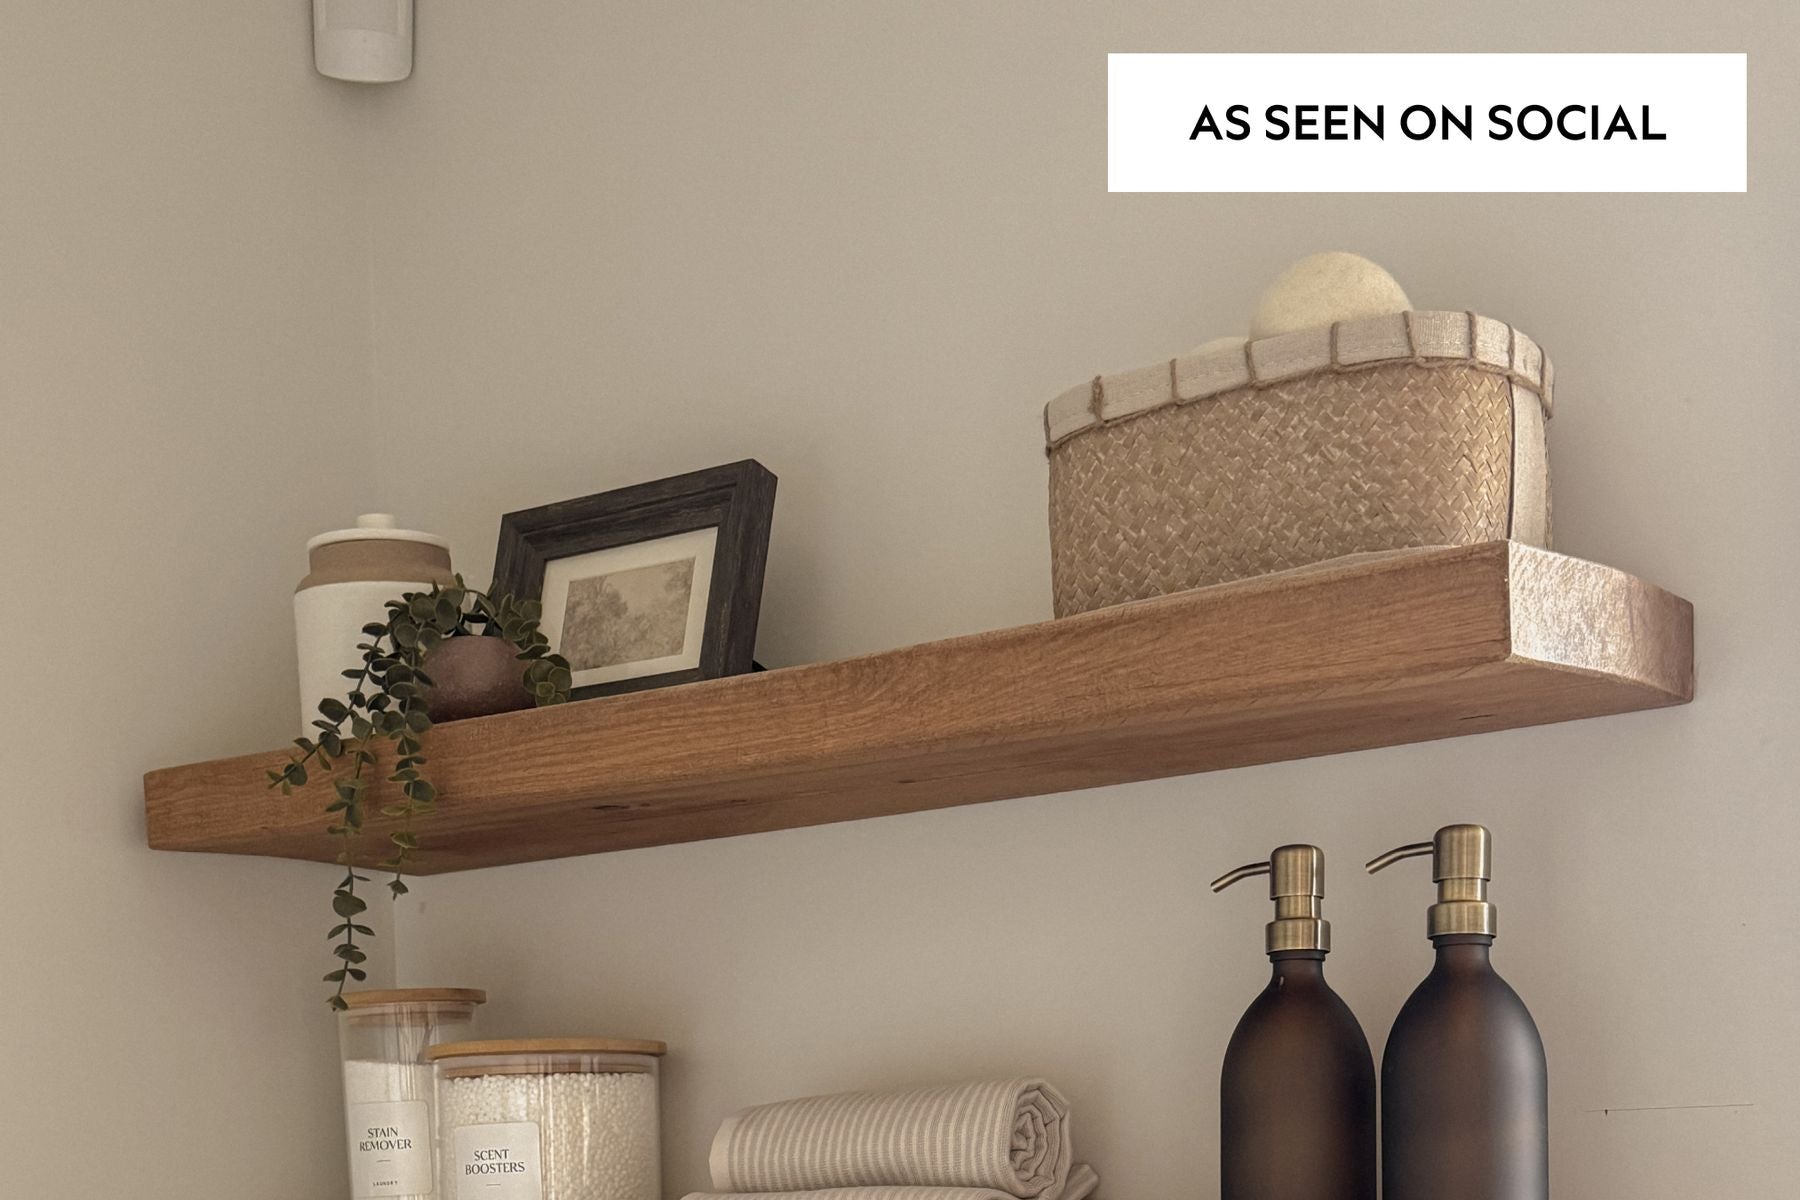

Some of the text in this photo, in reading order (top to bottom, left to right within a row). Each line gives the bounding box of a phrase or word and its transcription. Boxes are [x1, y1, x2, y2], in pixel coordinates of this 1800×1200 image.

[367, 1127, 399, 1139] STAIN
[359, 1138, 412, 1152] REMOVER
[474, 1148, 510, 1161] SCENT
[465, 1161, 526, 1176] BOOSTERS
